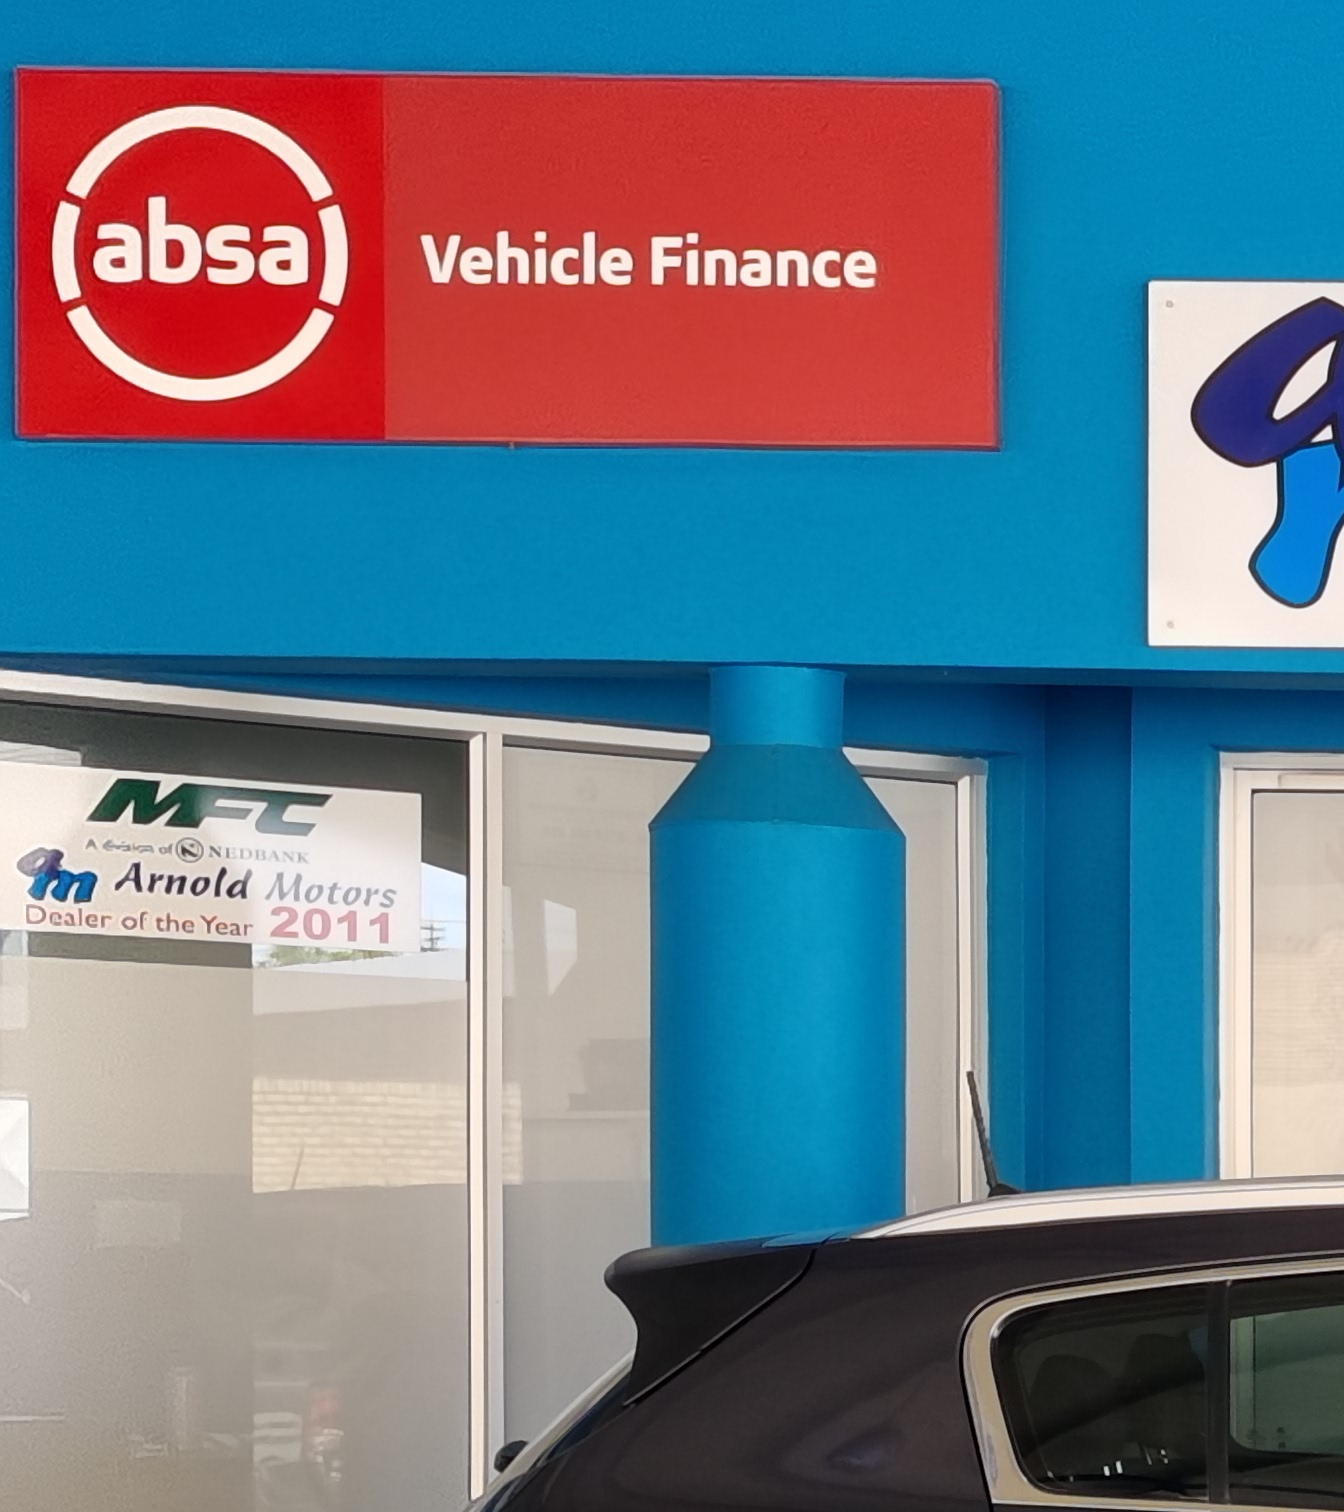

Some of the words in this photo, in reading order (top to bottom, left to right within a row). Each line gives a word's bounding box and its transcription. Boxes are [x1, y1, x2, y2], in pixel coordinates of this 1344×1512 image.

[92, 196, 310, 285] absa
[421, 232, 632, 285] Vehicle
[651, 233, 877, 288] Finance
[86, 778, 333, 837] MFC
[85, 838, 97, 850] A
[209, 845, 310, 865] NEDBANK
[114, 862, 253, 900] Arnold
[265, 872, 397, 909] Motors
[26, 904, 112, 929] Dealer
[122, 910, 149, 930] of
[155, 911, 194, 933] the
[200, 914, 254, 937] Year
[270, 906, 391, 944] 2011
